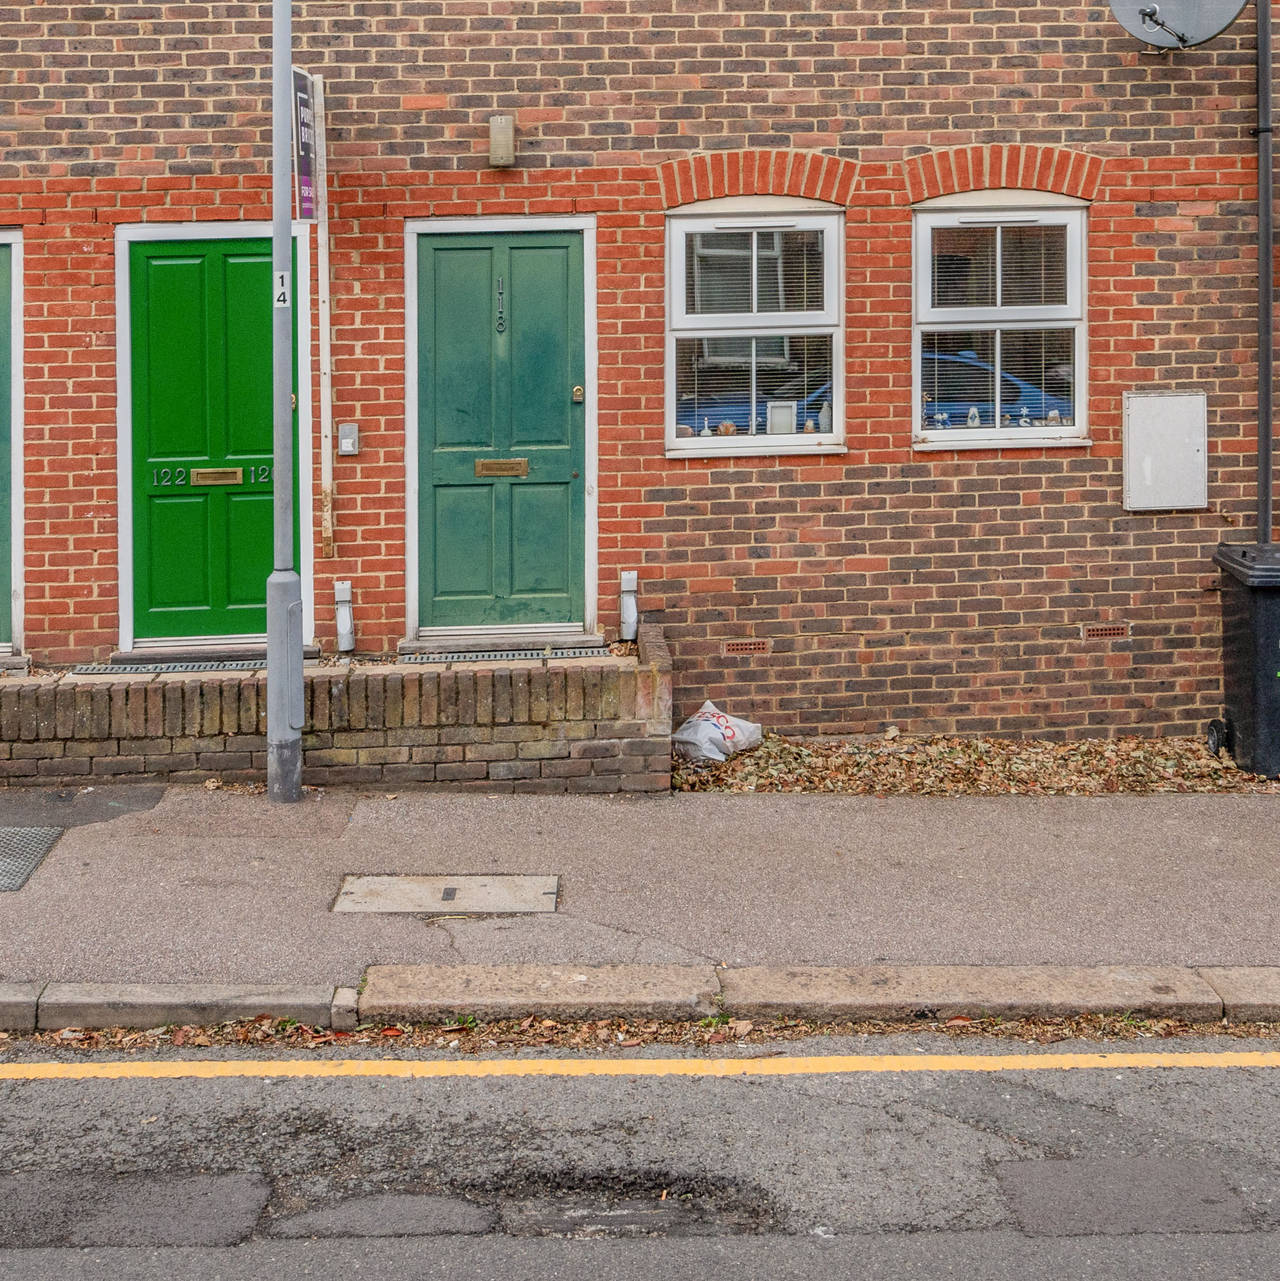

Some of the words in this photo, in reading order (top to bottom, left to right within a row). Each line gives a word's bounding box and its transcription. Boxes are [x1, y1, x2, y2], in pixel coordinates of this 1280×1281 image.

[496, 276, 505, 331] 118
[153, 468, 186, 486] 122
[251, 466, 274, 483] 12
